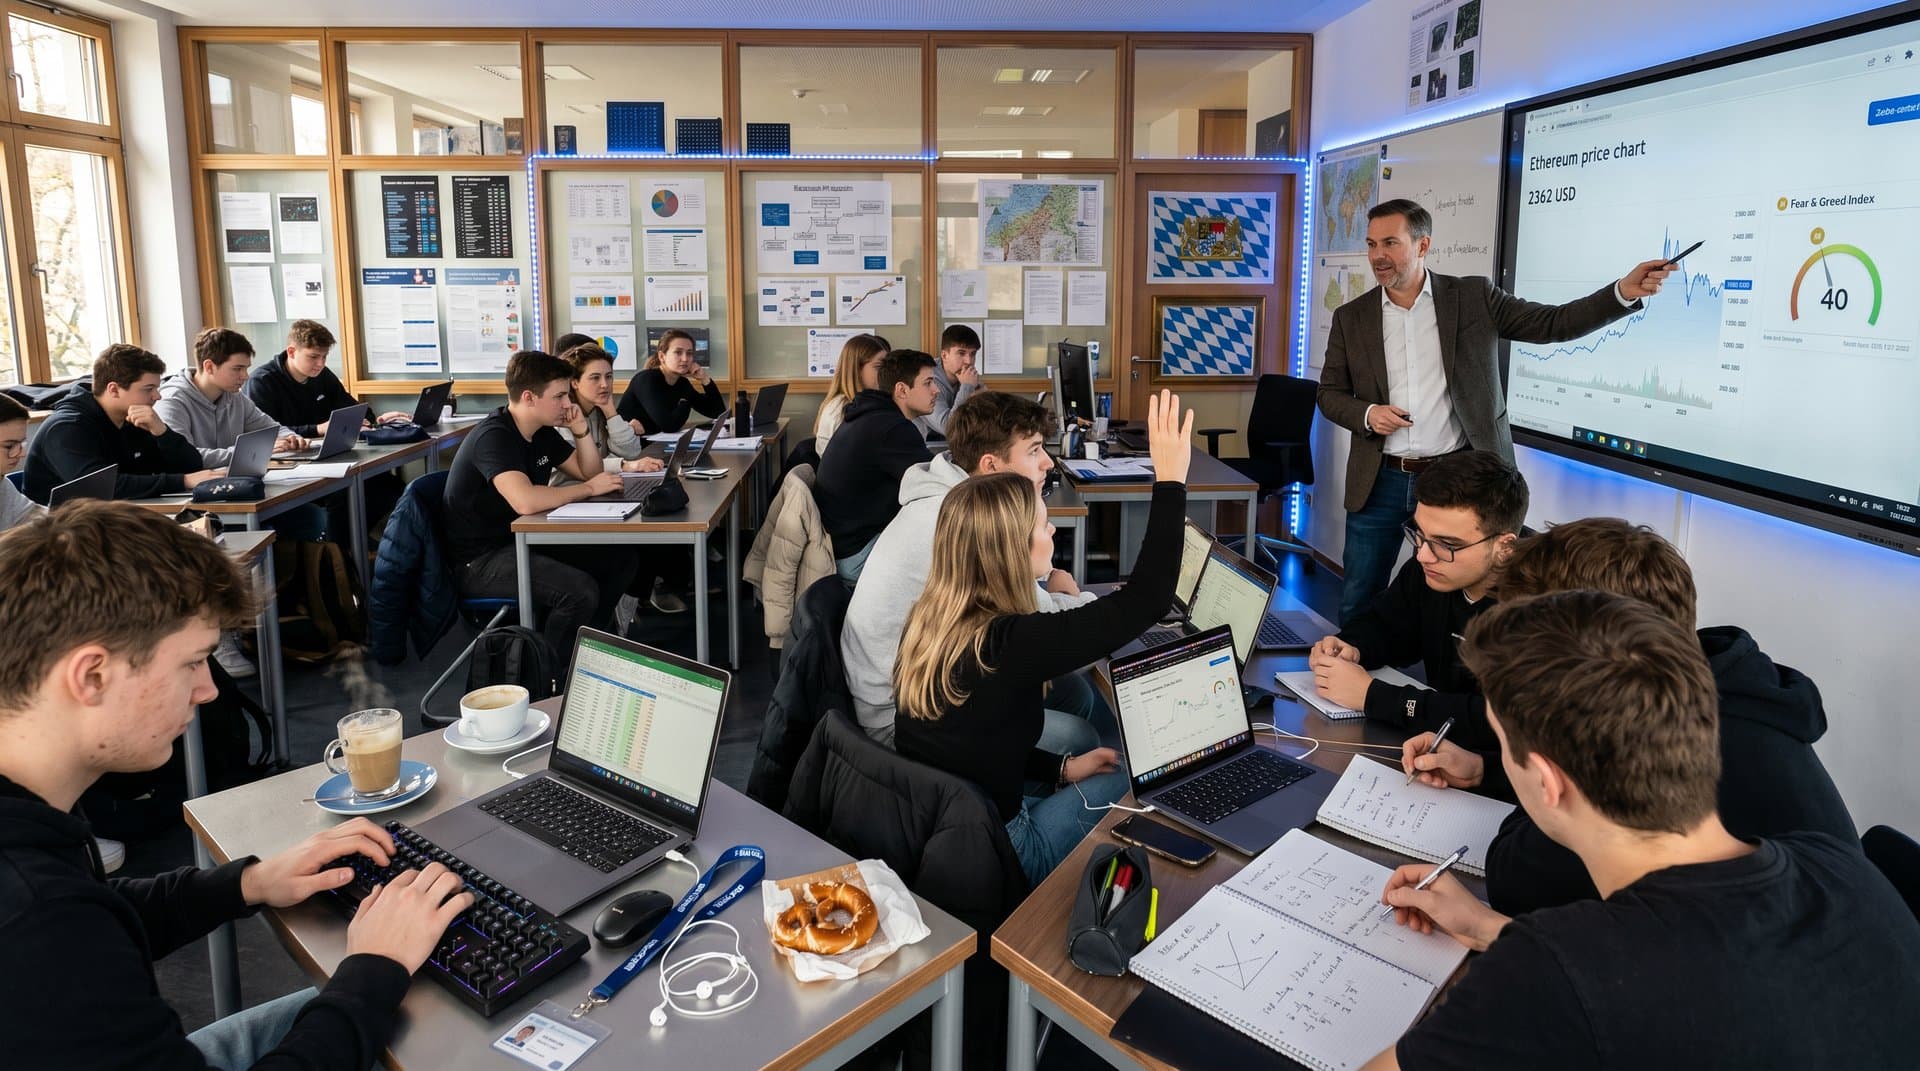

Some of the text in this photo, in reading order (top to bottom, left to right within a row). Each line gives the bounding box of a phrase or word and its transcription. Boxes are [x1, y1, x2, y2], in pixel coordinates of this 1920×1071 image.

[1530, 140, 1647, 171] Ethereum price chart
[1528, 187, 1576, 205] 2362 USD
[1791, 194, 1875, 208] Fear & Greed Index
[1821, 288, 1848, 310] 40
